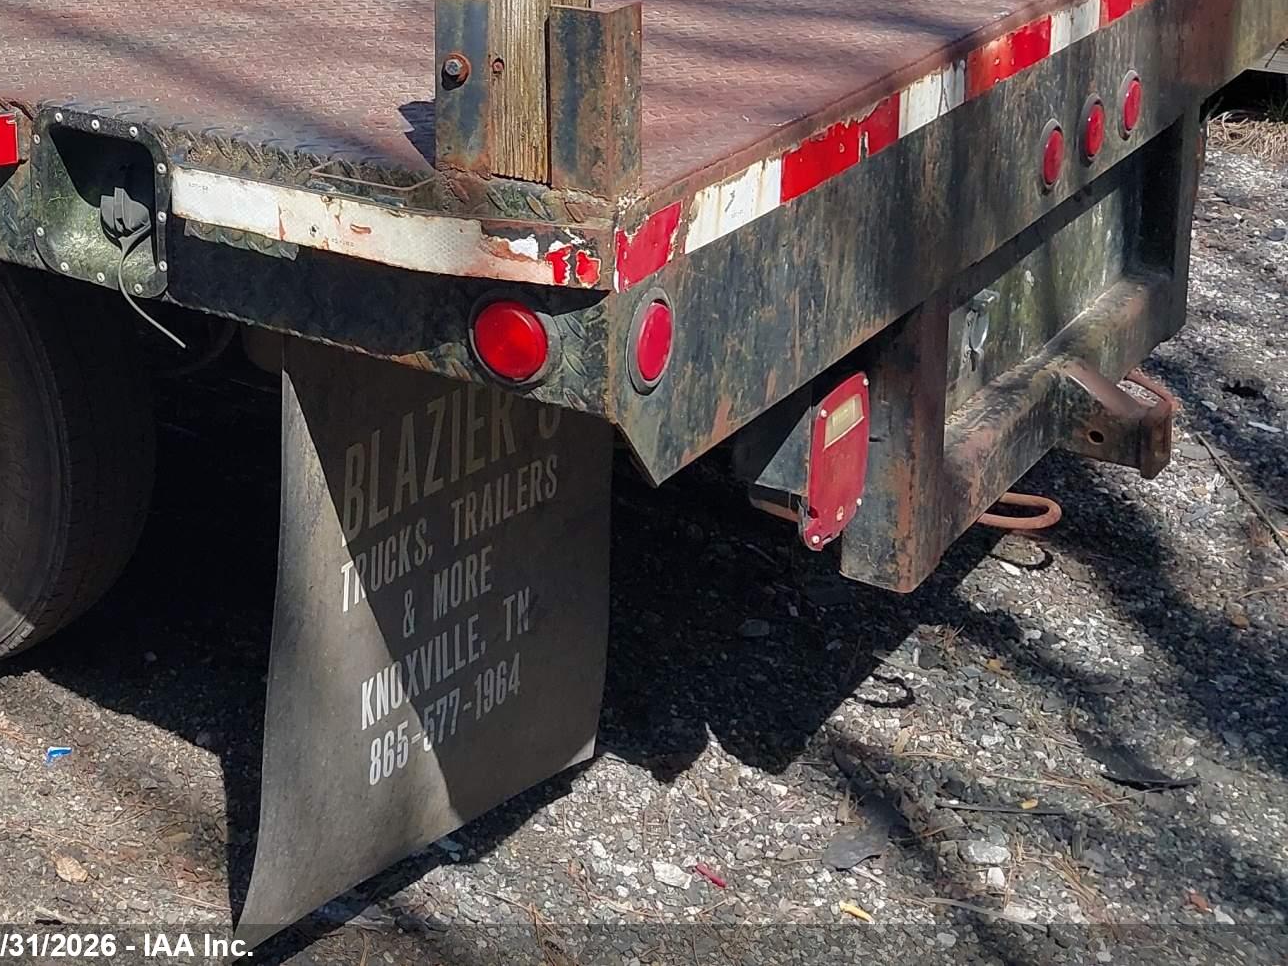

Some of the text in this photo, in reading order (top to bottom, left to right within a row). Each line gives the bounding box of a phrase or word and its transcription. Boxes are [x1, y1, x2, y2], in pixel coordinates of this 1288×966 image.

[340, 454, 558, 613] TRUCKS, TRAILERS
[341, 385, 561, 547] BLAZIER
[361, 586, 530, 731] KNOXVILLE, TN
[402, 545, 492, 638] & MORE
[369, 652, 521, 786] 865-577-1964
